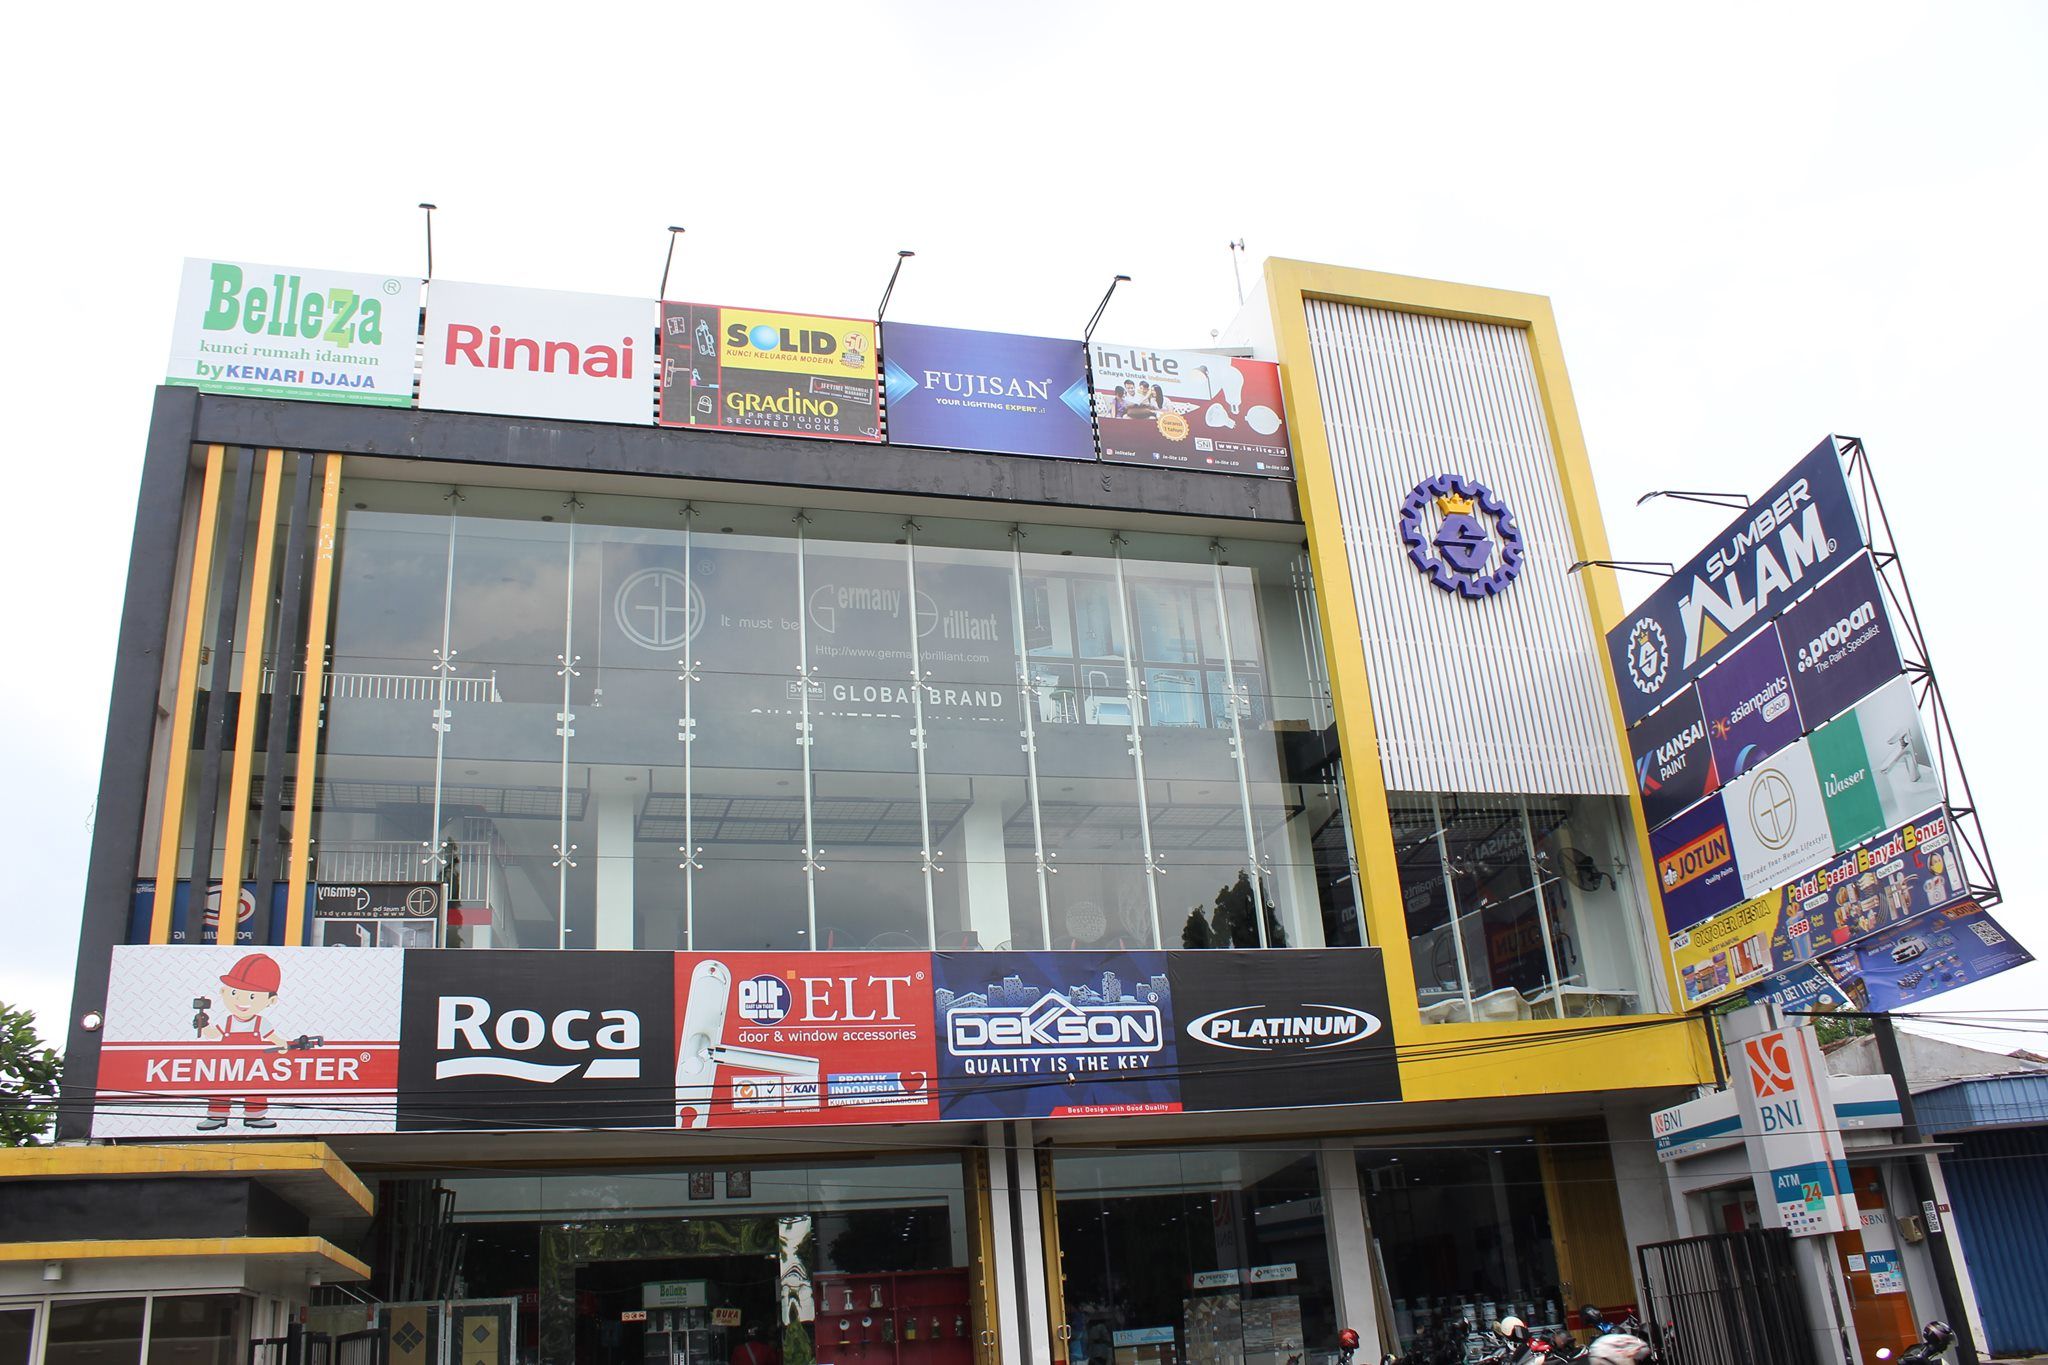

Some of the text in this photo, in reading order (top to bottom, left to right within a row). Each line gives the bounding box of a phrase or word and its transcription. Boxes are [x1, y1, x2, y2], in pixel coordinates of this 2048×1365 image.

[203, 263, 383, 348] Belleza
[445, 323, 633, 379] Rinnai
[727, 323, 837, 356] SOLID
[200, 340, 379, 366] kunci rumah idaman
[727, 350, 752, 358] KUNCI
[754, 351, 798, 362] KELUARGA
[800, 356, 834, 365] MODERN
[196, 360, 375, 388] by KENARI DJAJA
[924, 371, 1048, 400] FUJISAN
[1099, 369, 1124, 378] Cahaya
[1125, 372, 1147, 380] Untuk
[748, 412, 839, 425] PRESTIGIOUS
[936, 398, 1037, 413] YOUR LIGHTING EXPERT
[726, 417, 840, 432] SECURED LOCKS
[1706, 478, 1811, 582] SUMBER
[739, 617, 773, 630] must
[782, 617, 800, 631] be
[1809, 601, 1876, 663] propan
[1815, 624, 1880, 673] The Paint Specialist
[930, 689, 1002, 708] BRAND
[1730, 676, 1788, 724] asianpaints
[1656, 720, 1705, 766] KANSAI
[1660, 753, 1687, 781] PAINT
[1825, 769, 1865, 798] Wasser
[1679, 835, 1726, 880] JOTUN
[1816, 859, 1858, 892] Spesial
[1857, 837, 1903, 872] Banyak
[1902, 817, 1945, 852] Bonus
[1694, 900, 1771, 947] OKTOBER FIESTA
[800, 975, 911, 1021] ELT
[1783, 985, 1801, 1002] GET
[437, 996, 641, 1051] Roca
[738, 1028, 917, 1043] door & window accessories
[1211, 1016, 1356, 1039] PLATINUM
[146, 1057, 360, 1083] KENMASTER
[965, 1055, 1150, 1075] QUALITY IS THE KEY
[793, 1084, 817, 1094] KAN
[830, 1085, 896, 1095] INDONESIA
[838, 1075, 888, 1085] PRODUK
[1085, 1105, 1108, 1113] Design
[1126, 1104, 1143, 1112] Good
[1145, 1103, 1169, 1111] Quality
[1663, 1109, 1682, 1132] BNI
[1760, 1099, 1802, 1132] BNI
[1778, 1173, 1800, 1188] ATM
[1803, 1183, 1822, 1203] 24
[1870, 1255, 1886, 1265] ATM
